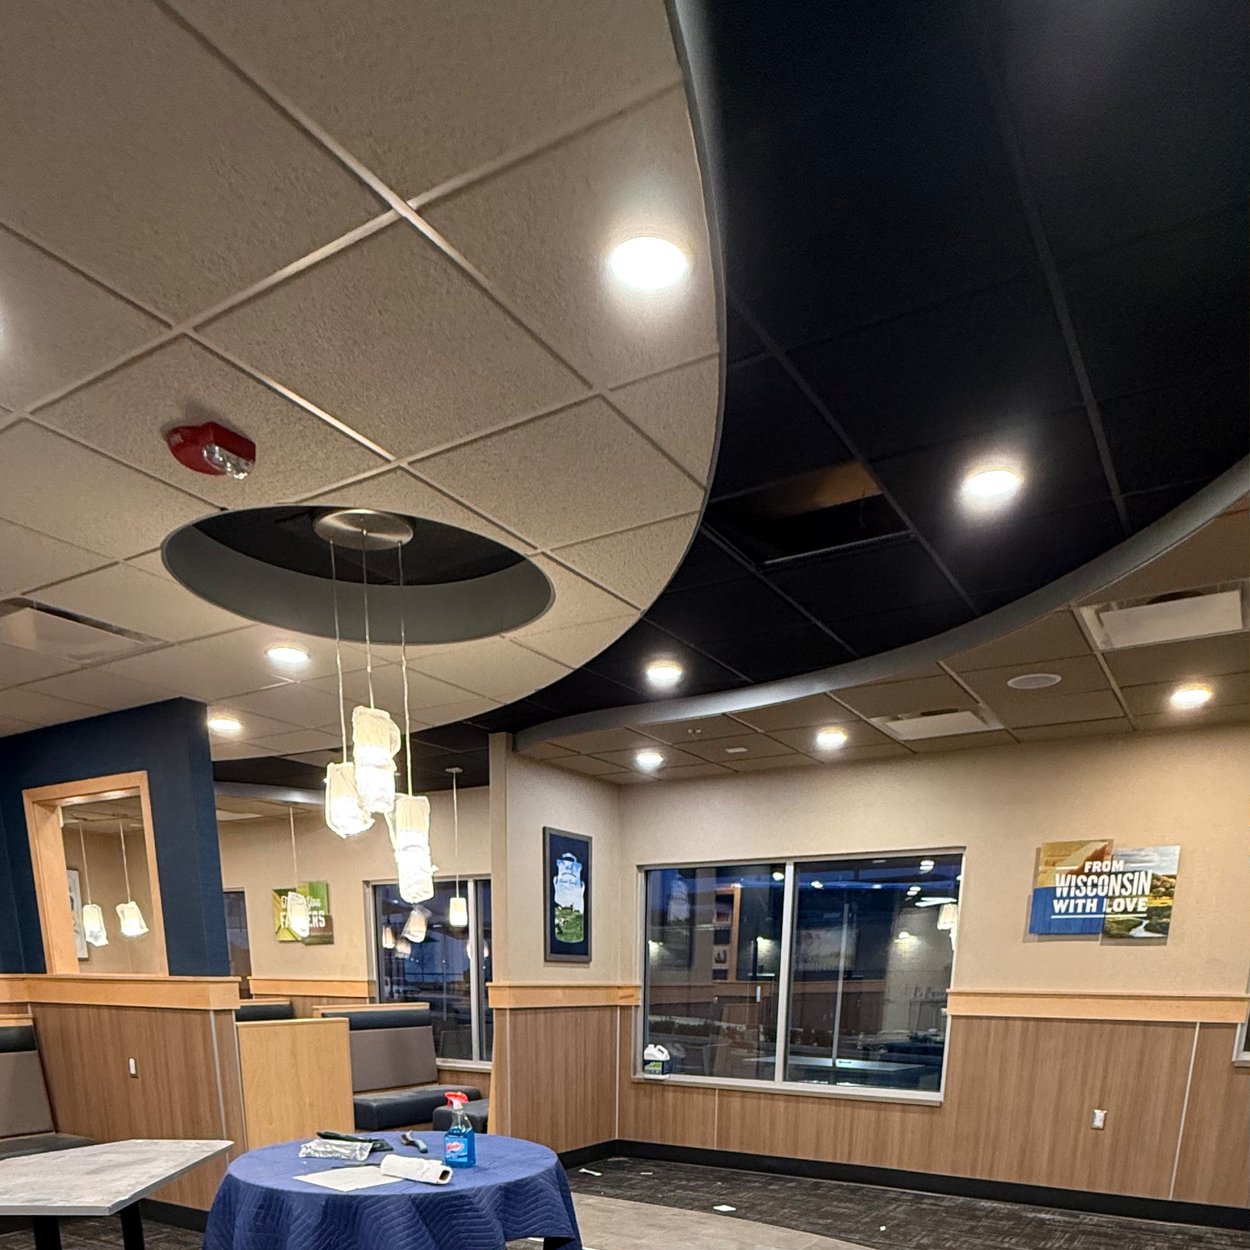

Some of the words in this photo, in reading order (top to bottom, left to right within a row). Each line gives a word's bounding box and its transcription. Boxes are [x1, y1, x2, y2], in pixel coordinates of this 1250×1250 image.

[1084, 860, 1125, 873] FROM
[1055, 870, 1153, 898] WISCONSIN
[1053, 898, 1098, 913] WITH
[1102, 897, 1149, 912] LOVE
